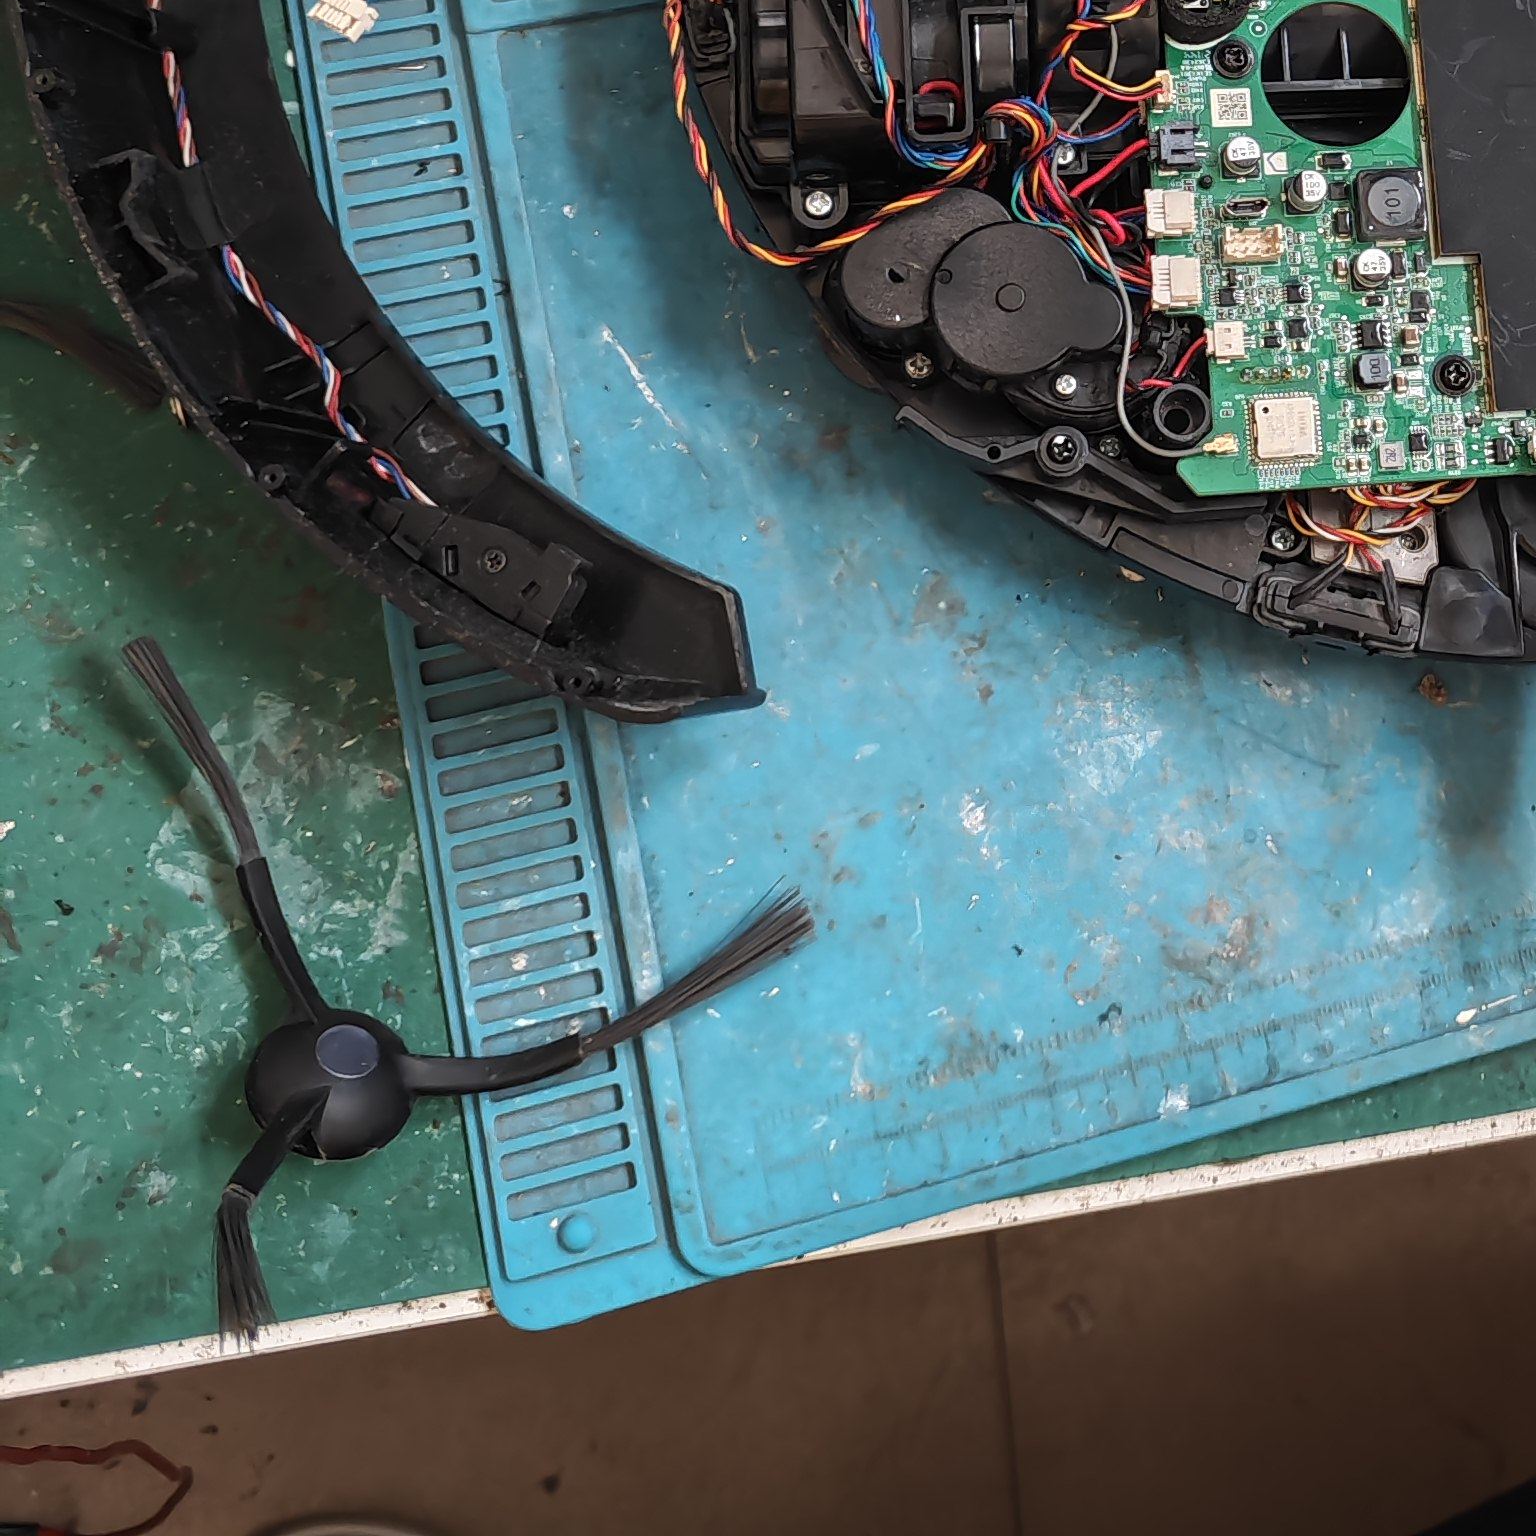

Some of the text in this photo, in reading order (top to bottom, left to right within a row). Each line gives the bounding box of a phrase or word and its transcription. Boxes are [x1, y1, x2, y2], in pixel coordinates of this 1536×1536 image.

[1305, 181, 1320, 189] 100
[1305, 189, 1321, 197] 35V
[1384, 187, 1402, 222] 101
[1369, 358, 1382, 380] 100
